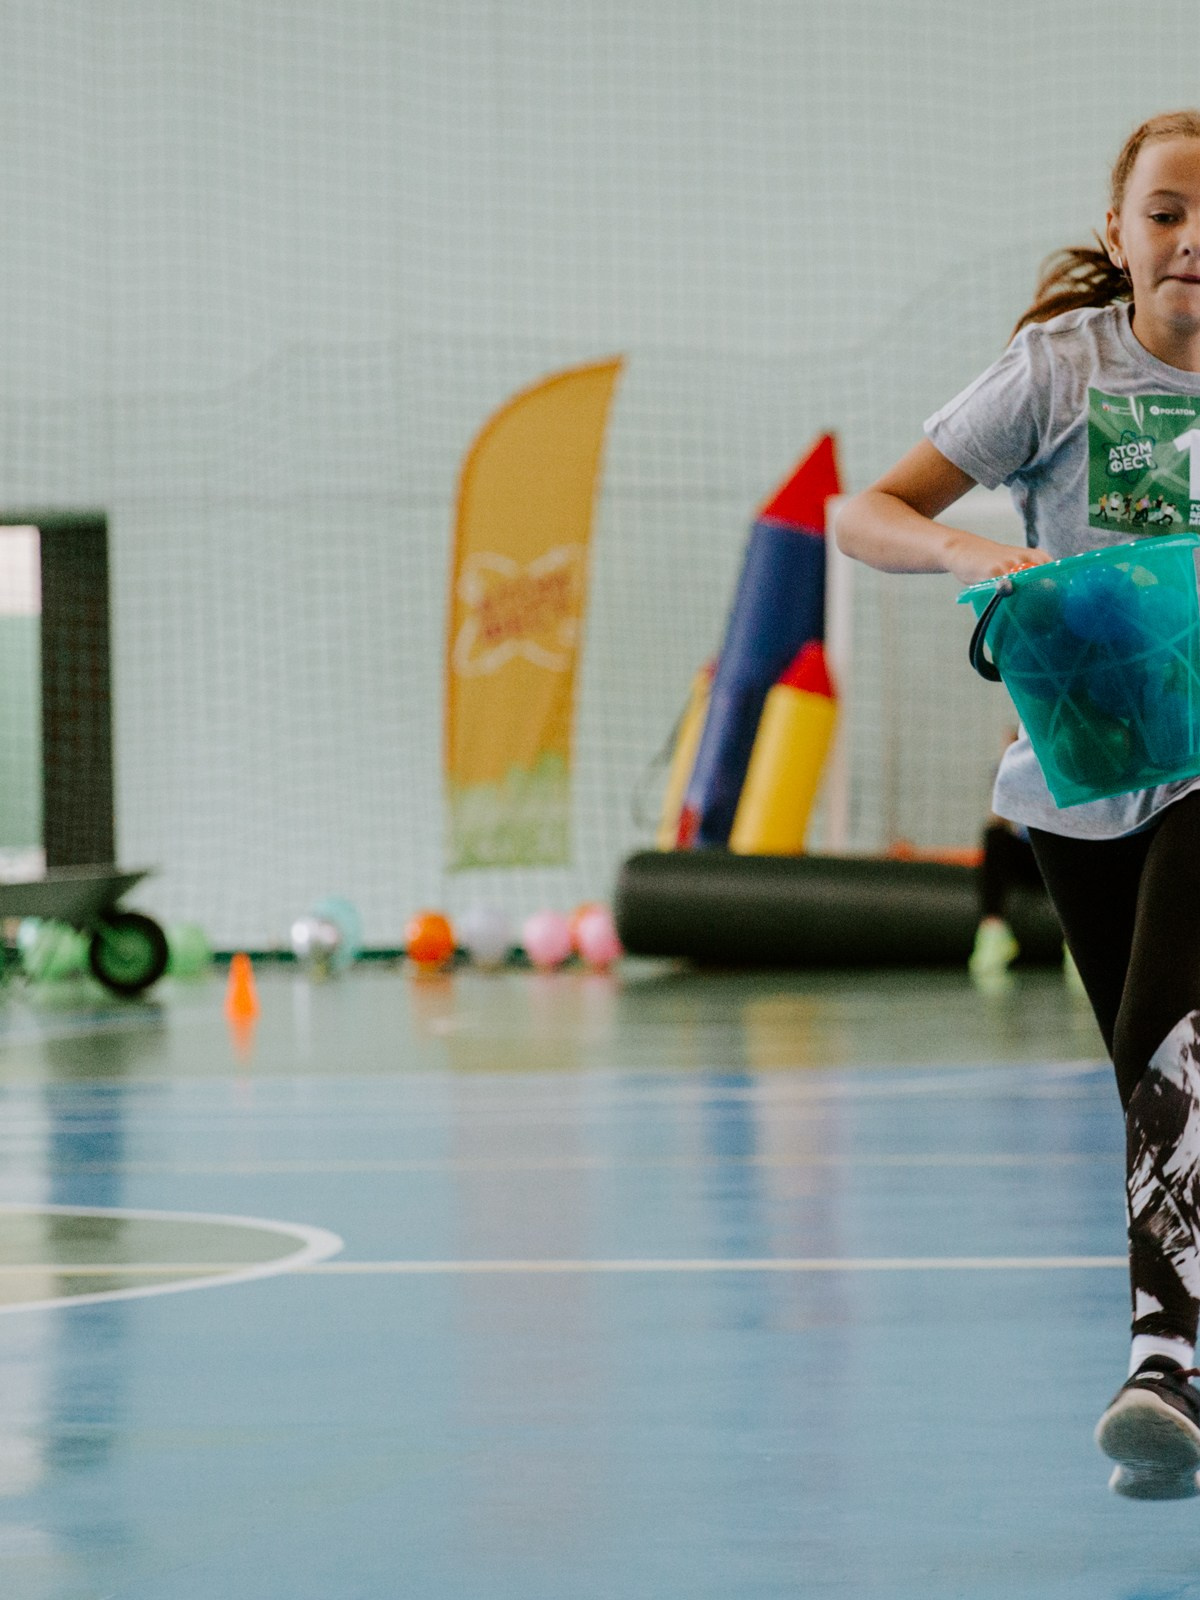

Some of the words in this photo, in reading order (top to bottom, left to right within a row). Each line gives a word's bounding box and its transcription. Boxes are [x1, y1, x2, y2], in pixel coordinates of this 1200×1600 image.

[1160, 408, 1196, 416] РОСАТОМ
[1109, 441, 1152, 460] АТОМ
[1110, 453, 1152, 473] ФЕСТ
